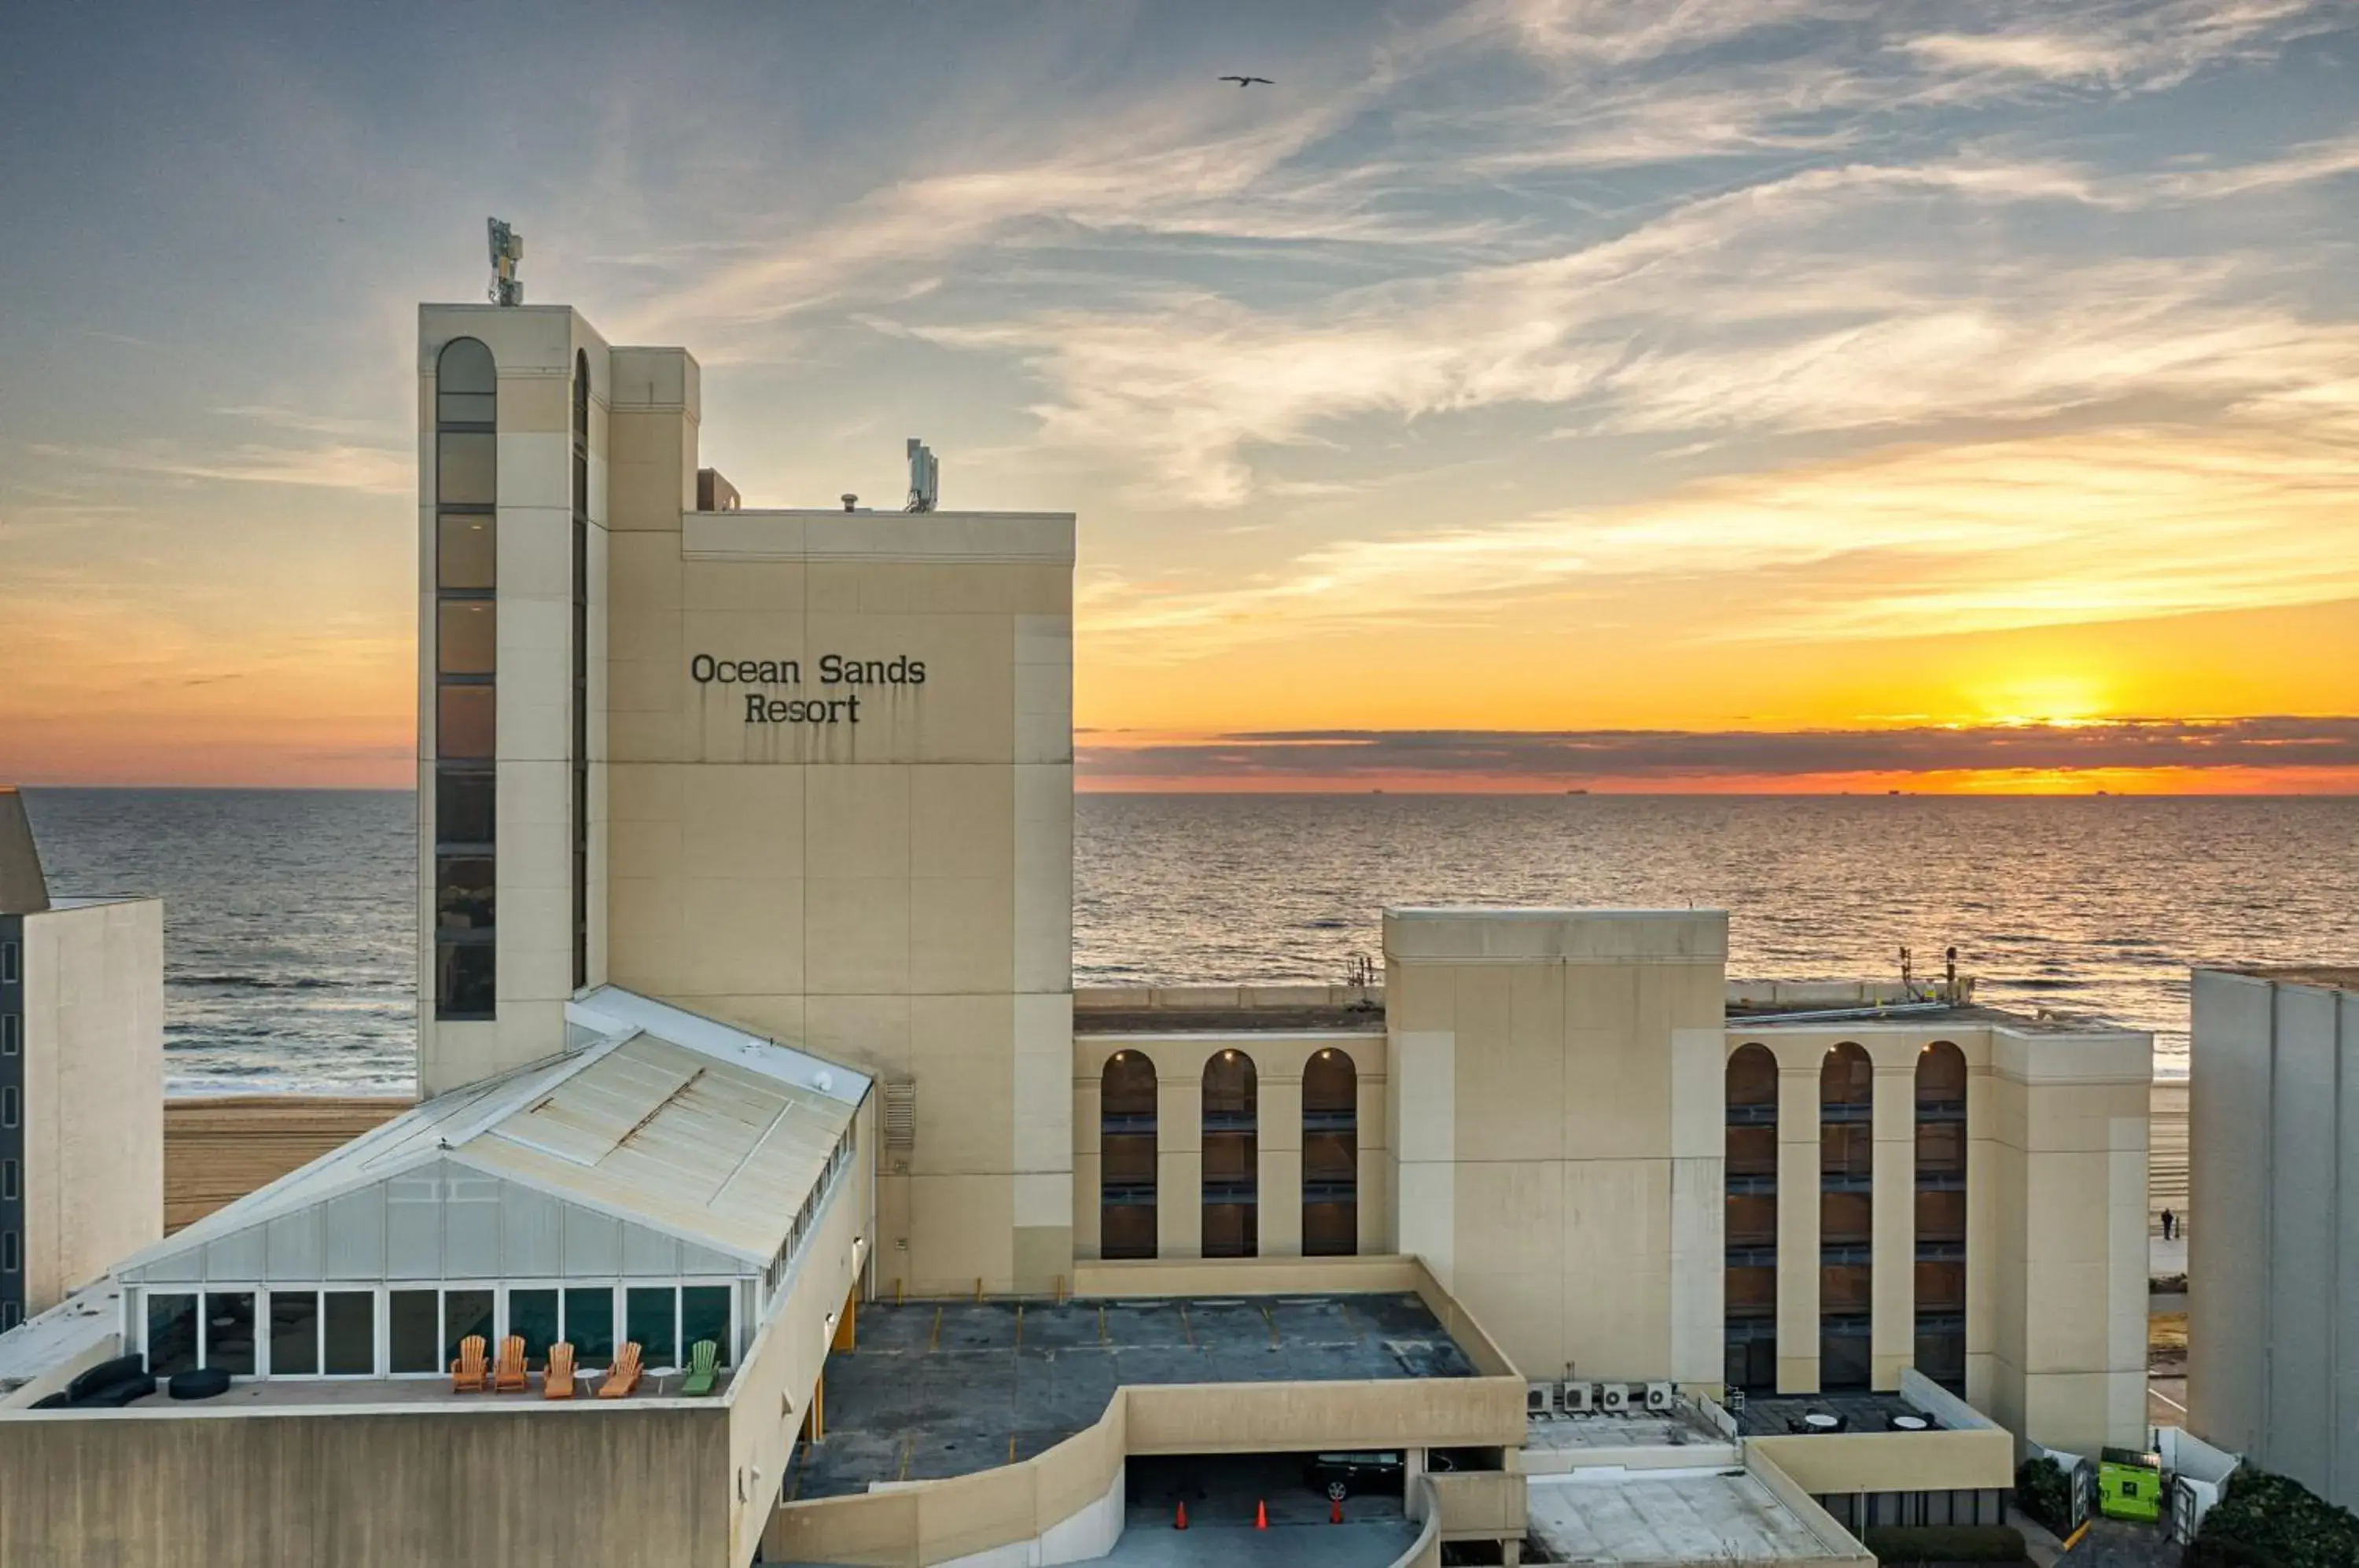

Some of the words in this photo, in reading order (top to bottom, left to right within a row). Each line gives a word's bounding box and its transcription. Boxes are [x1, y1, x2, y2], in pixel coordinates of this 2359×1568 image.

[692, 654, 800, 683] Ocean
[819, 655, 926, 683] Sands
[745, 694, 860, 723] Resort
